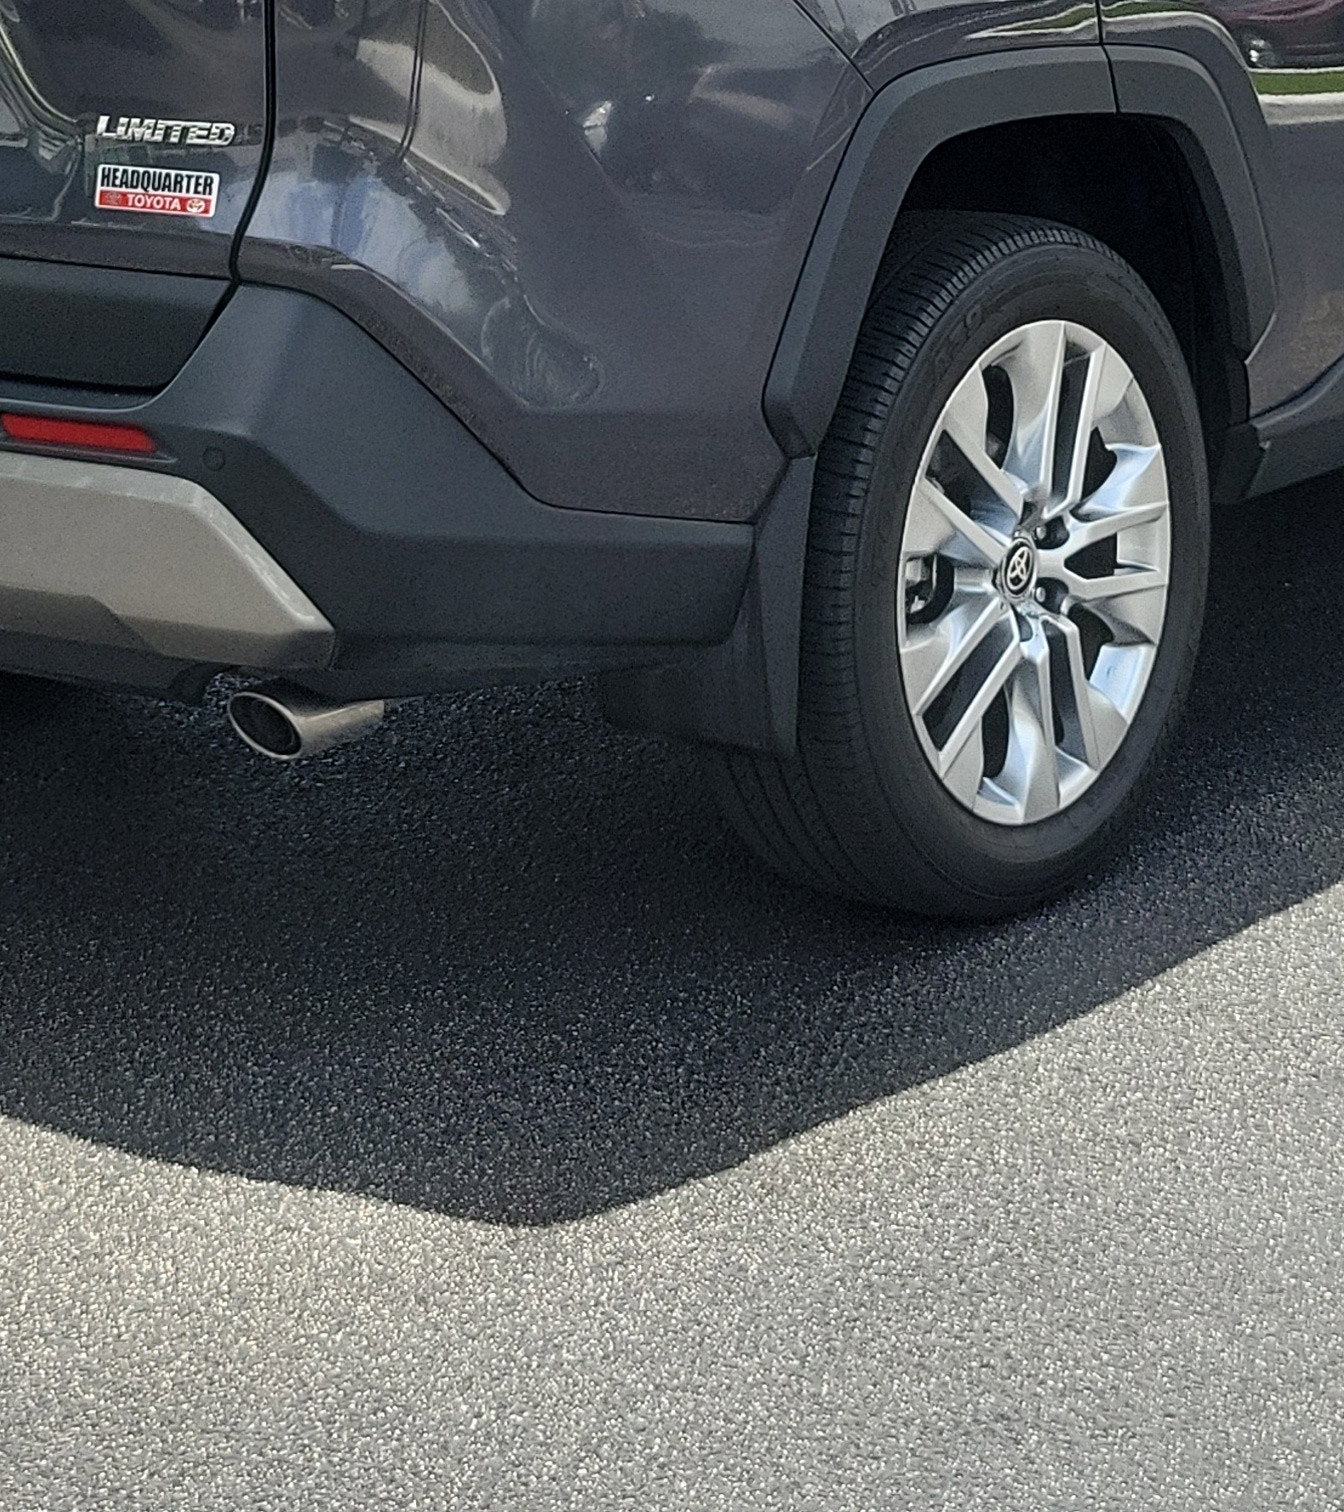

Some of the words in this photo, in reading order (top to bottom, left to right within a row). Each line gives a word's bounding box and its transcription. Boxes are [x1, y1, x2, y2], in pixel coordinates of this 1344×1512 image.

[96, 115, 235, 146] LIMITED
[100, 167, 215, 196] HEADQUARTER
[127, 194, 182, 211] TOYOTA
